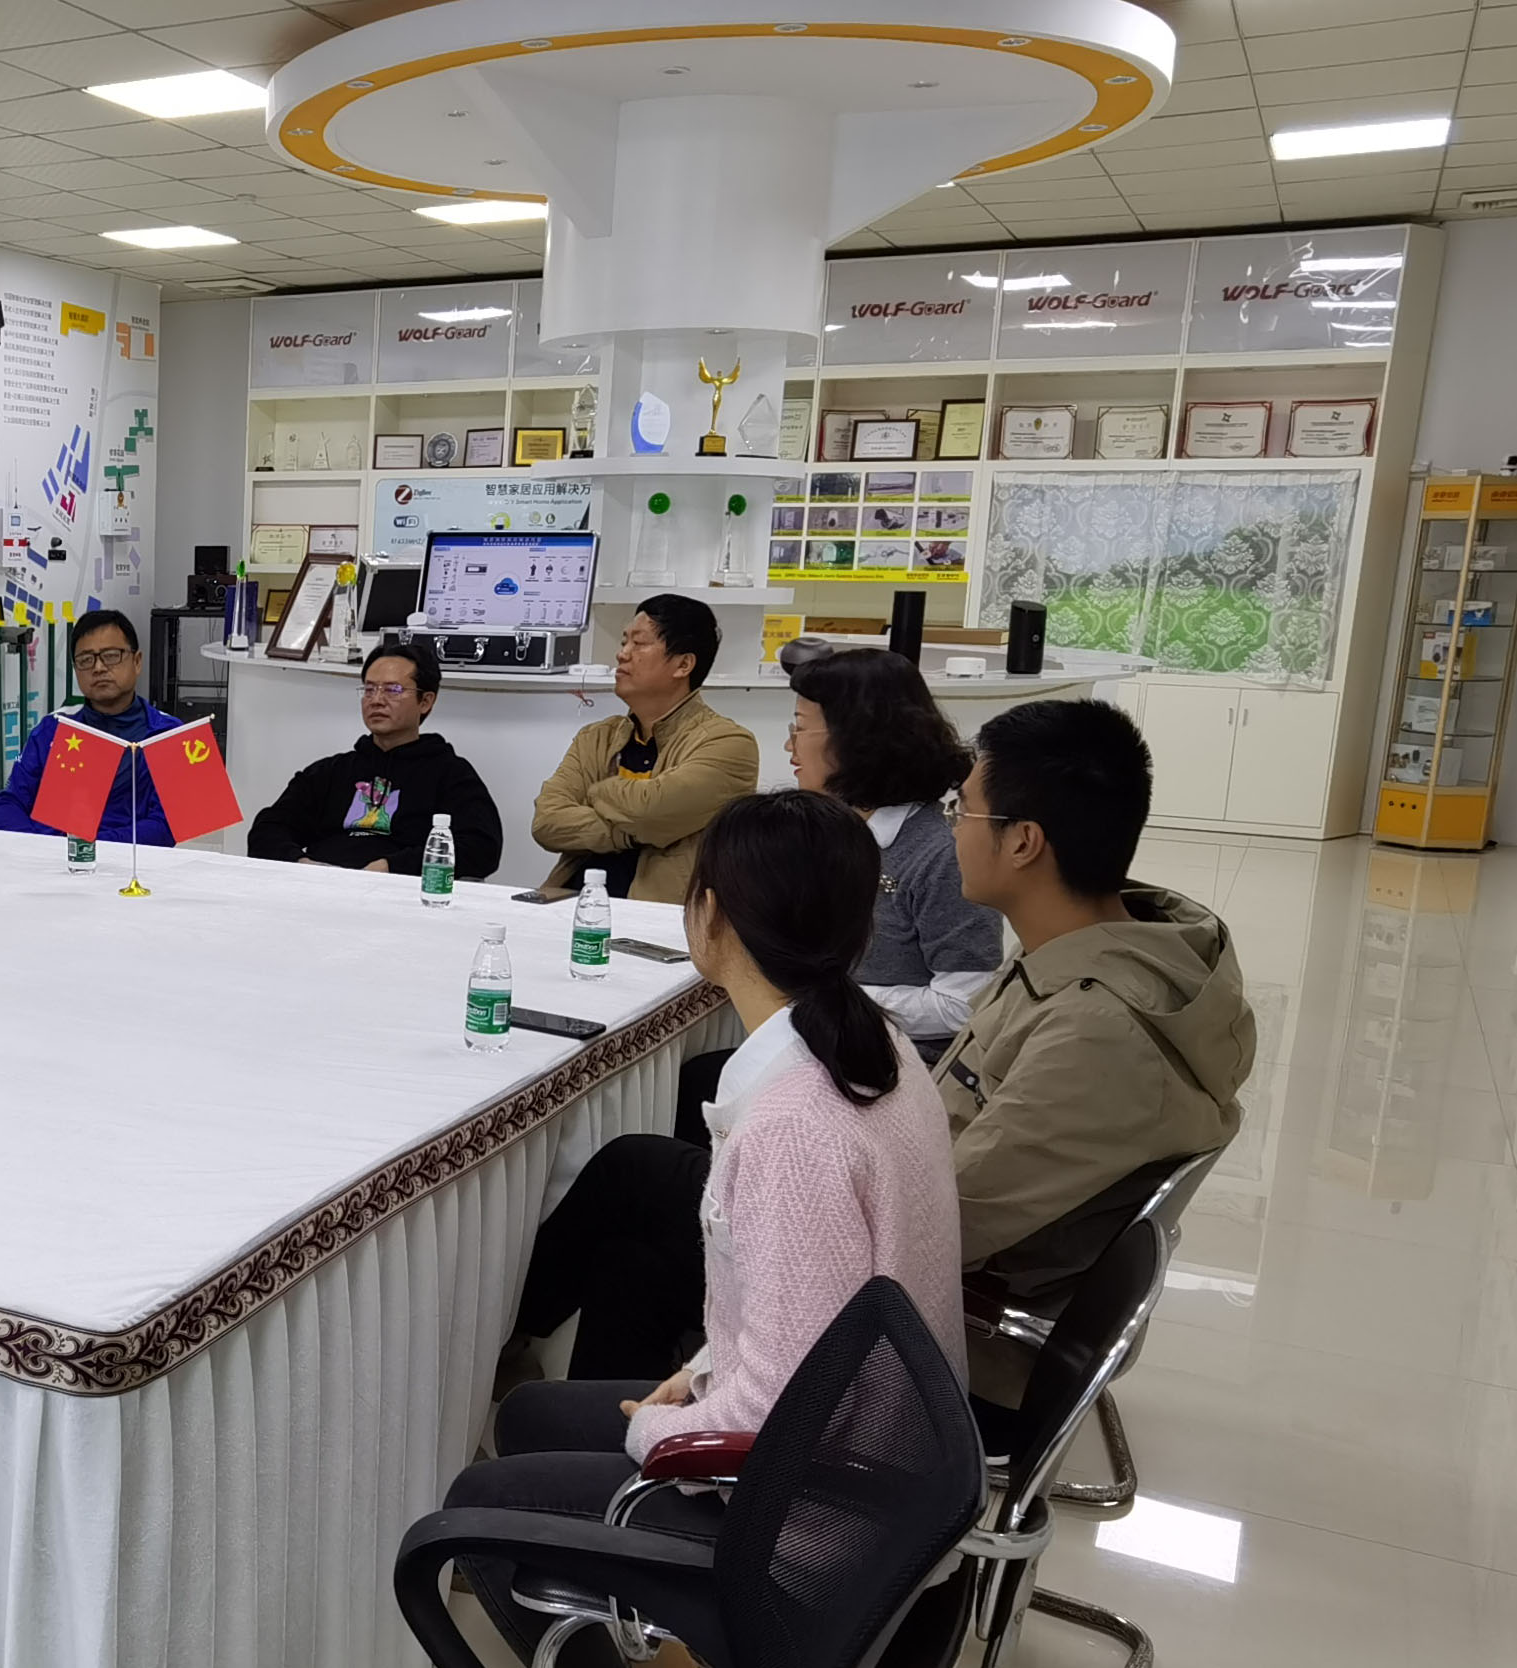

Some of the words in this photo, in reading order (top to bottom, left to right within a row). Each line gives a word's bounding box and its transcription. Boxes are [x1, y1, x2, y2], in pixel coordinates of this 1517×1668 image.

[851, 300, 964, 317] WOLF-Guard
[1027, 291, 1152, 311] WOLF-Guard
[269, 332, 353, 349] WOLF-Guard
[398, 325, 488, 342] WOLF-Guard
